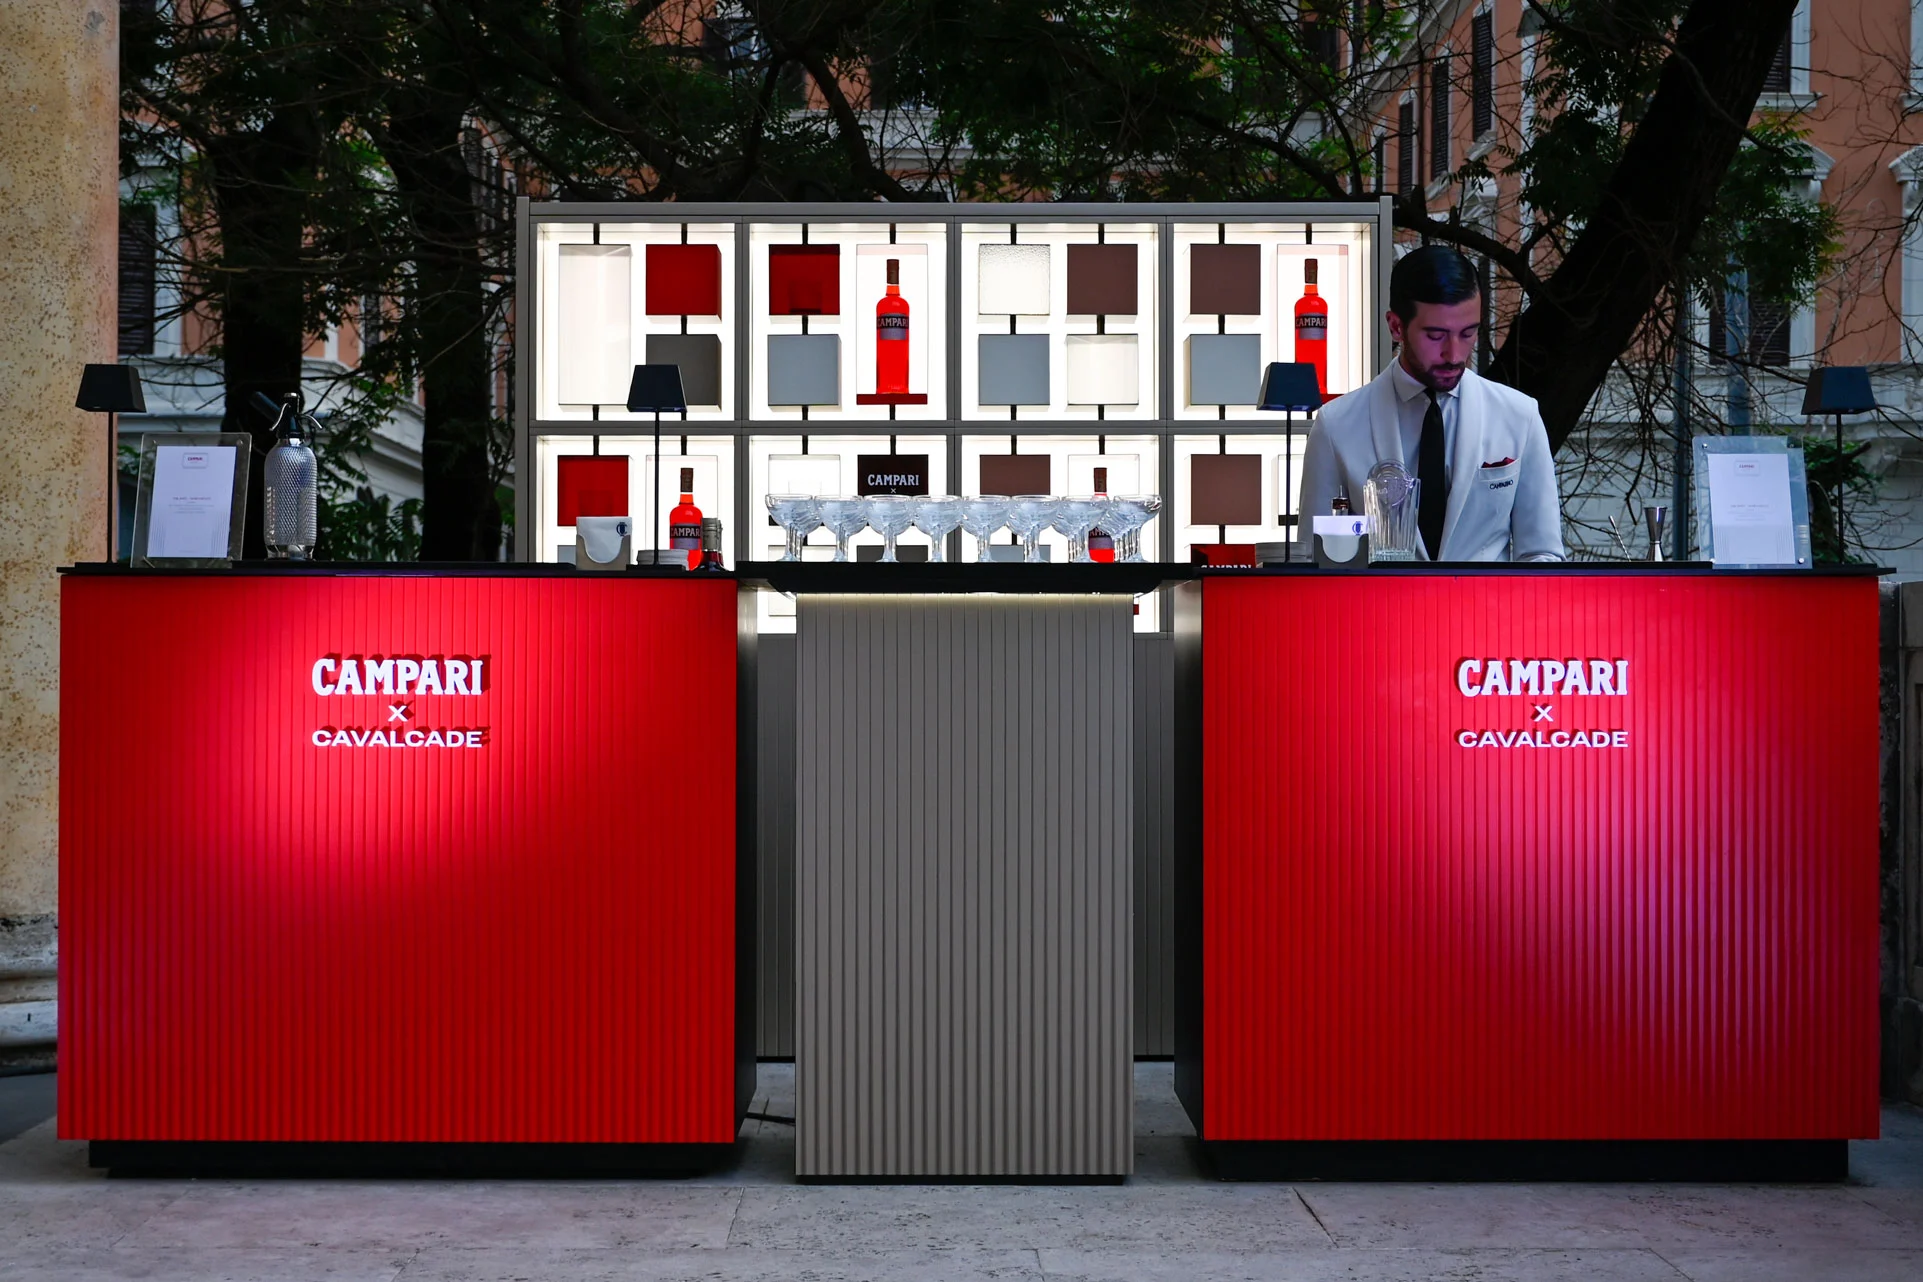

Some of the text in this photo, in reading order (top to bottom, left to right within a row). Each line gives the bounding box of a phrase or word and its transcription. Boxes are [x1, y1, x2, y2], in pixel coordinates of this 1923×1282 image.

[867, 474, 920, 486] CAMPARI
[670, 527, 702, 537] CAMPAR
[311, 657, 484, 696] CAMPARI
[1458, 659, 1629, 697] CAMPARI
[311, 729, 483, 748] CAVALCADE
[1458, 730, 1629, 748] CAVALCADE
